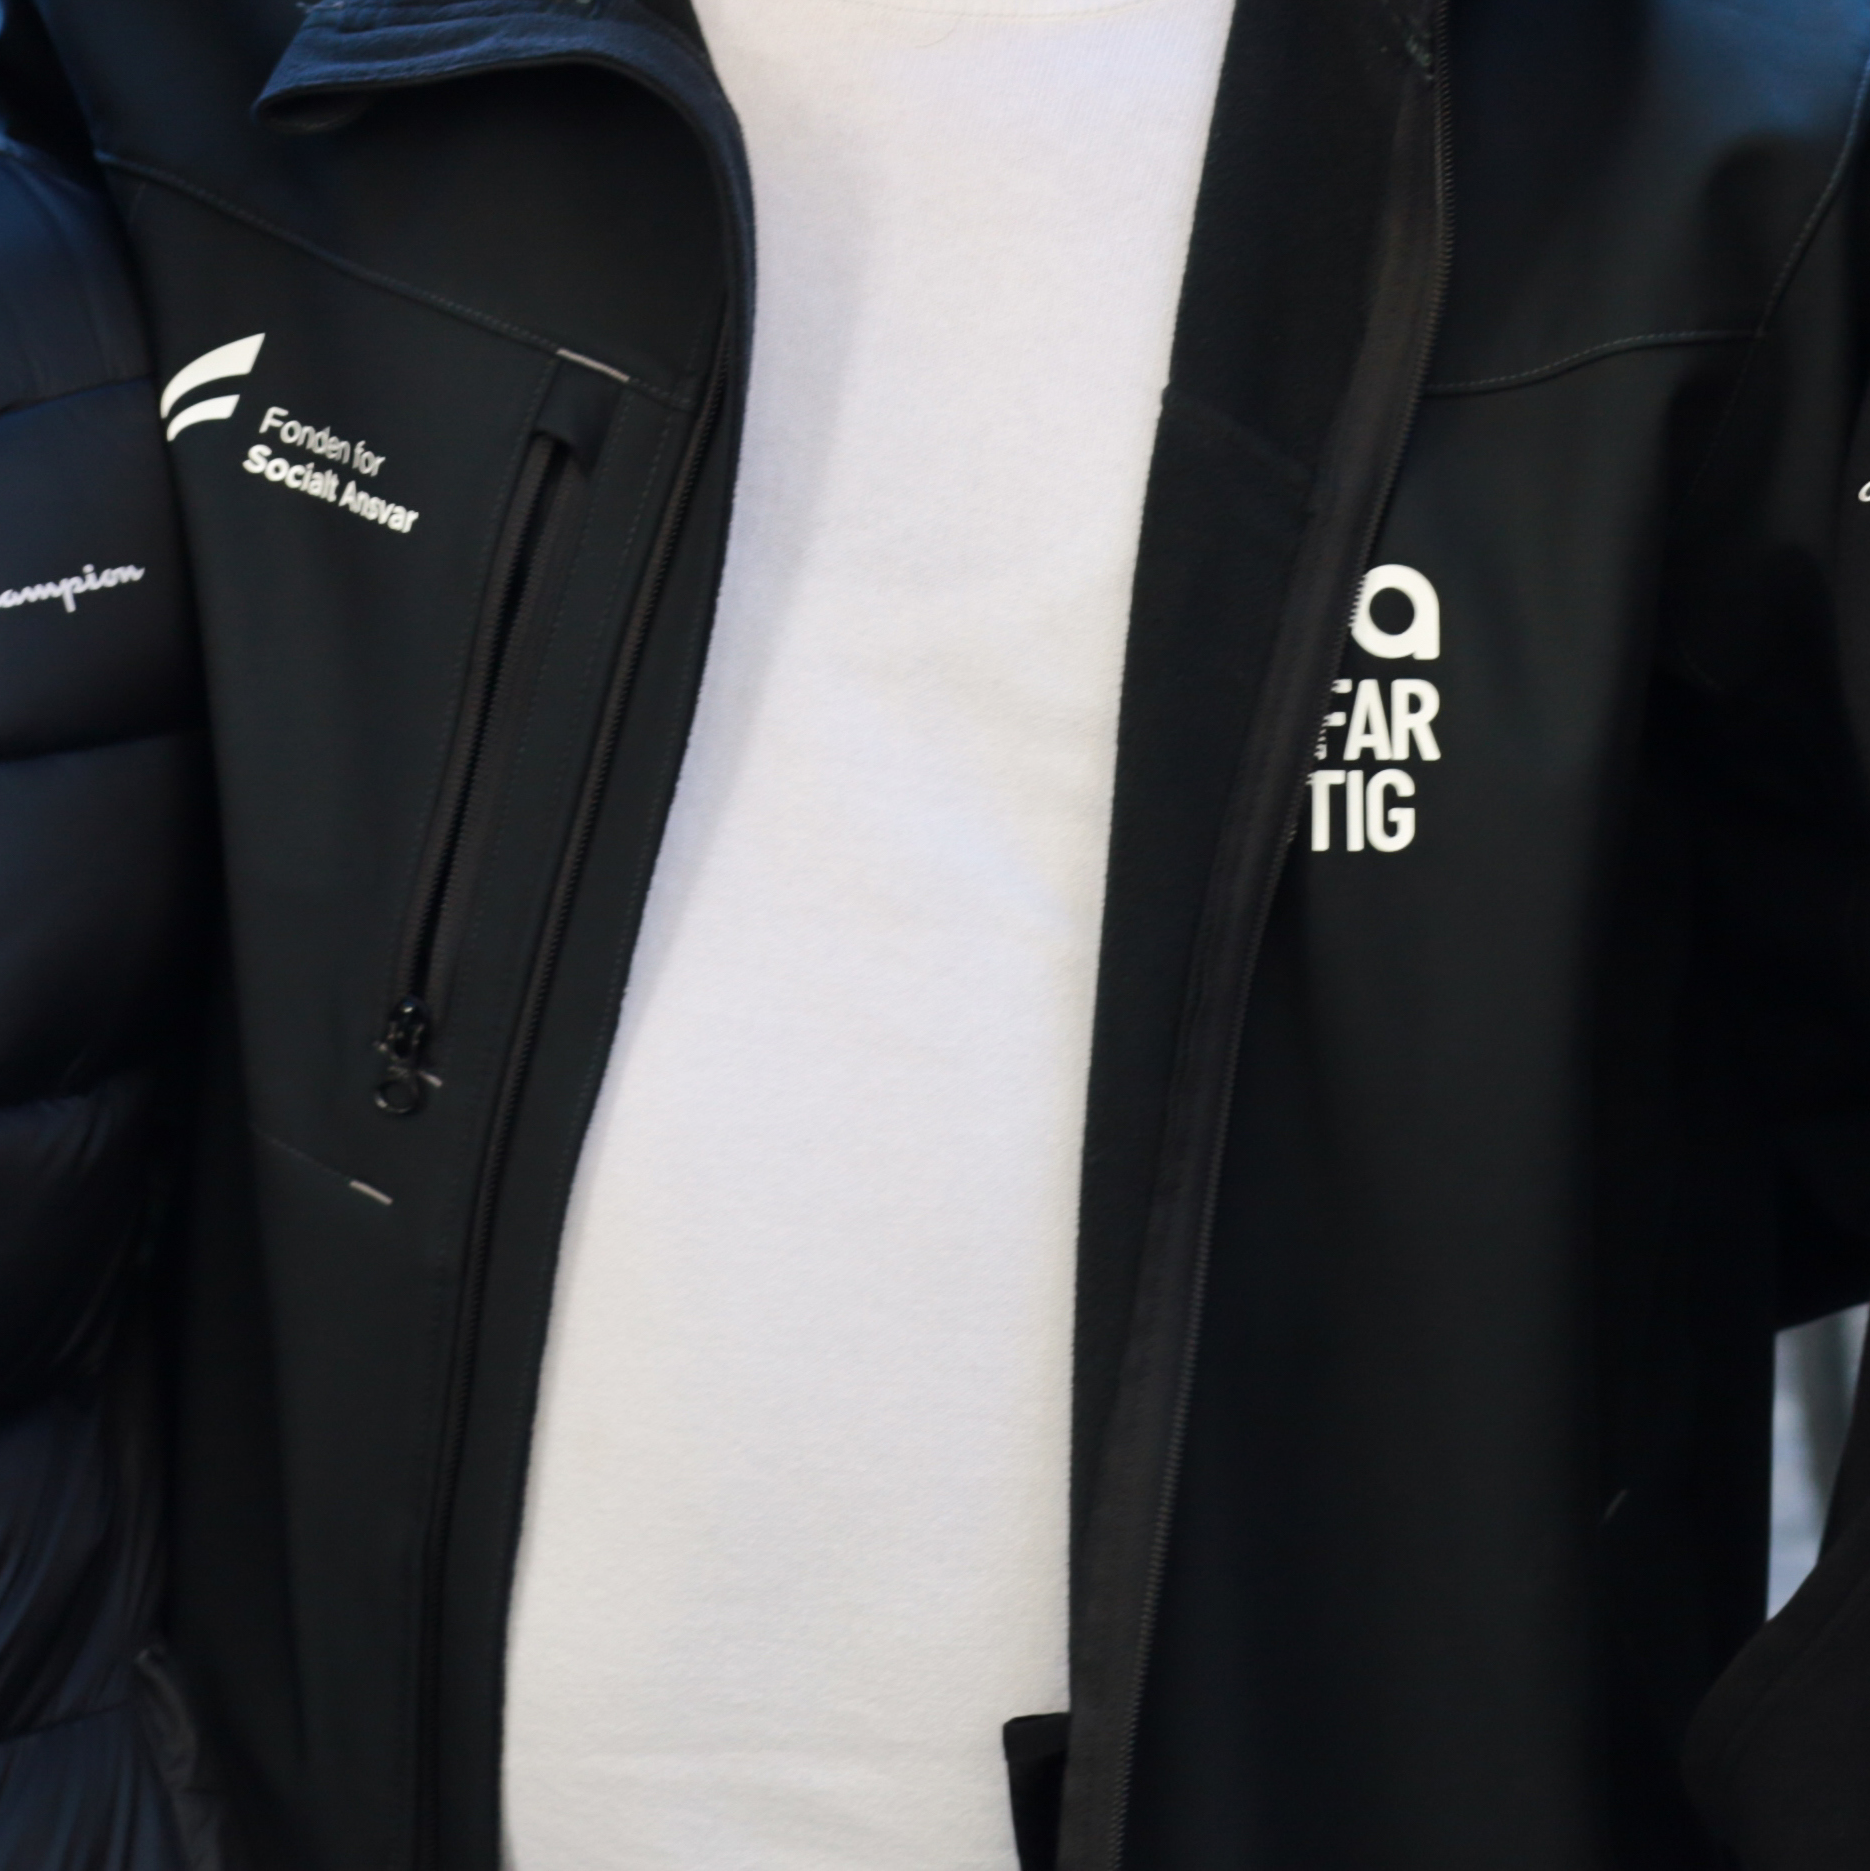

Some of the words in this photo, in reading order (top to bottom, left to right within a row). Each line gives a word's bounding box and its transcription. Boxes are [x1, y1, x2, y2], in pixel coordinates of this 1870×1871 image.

[259, 406, 350, 464] Fonden
[352, 440, 386, 477] for
[242, 444, 340, 503] Socialt
[338, 480, 419, 533] Ansvar
